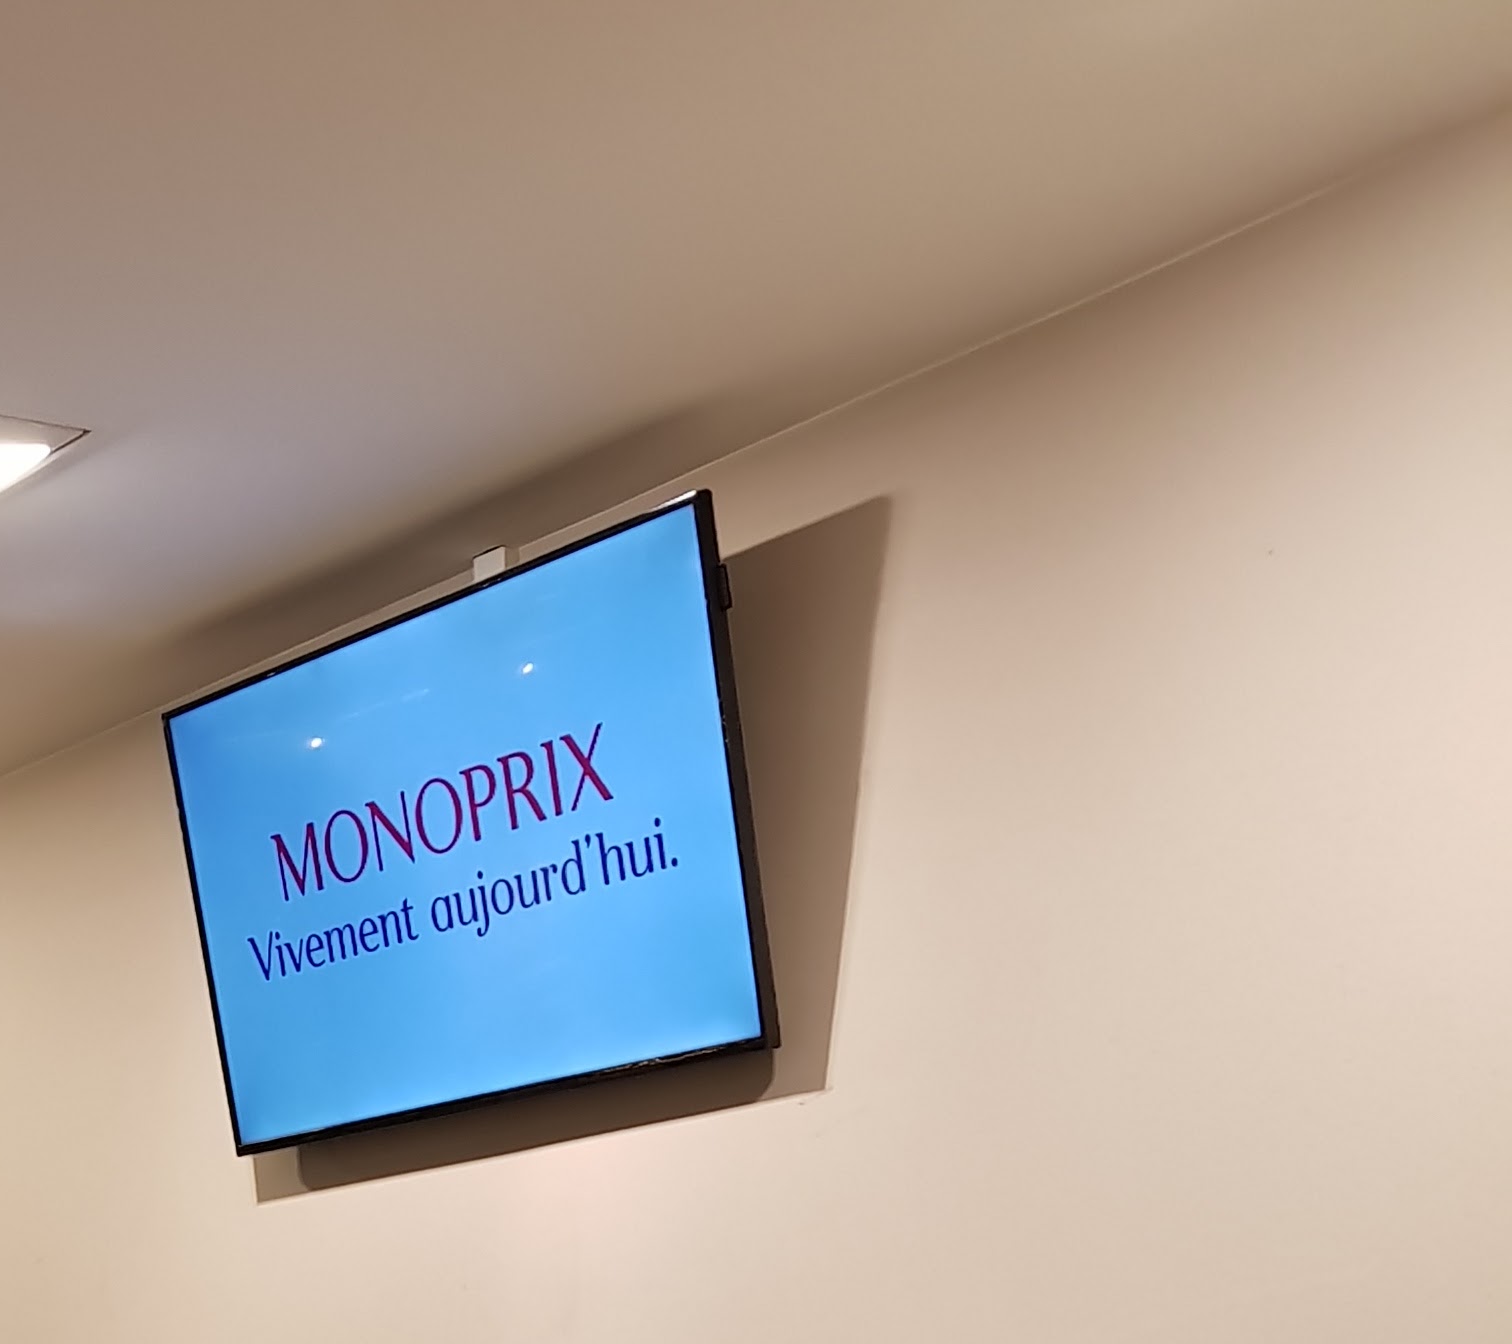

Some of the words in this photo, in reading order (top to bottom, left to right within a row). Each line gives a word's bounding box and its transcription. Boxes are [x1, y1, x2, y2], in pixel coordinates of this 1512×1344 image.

[270, 722, 615, 902] MONOPRIX
[247, 897, 419, 983] Vivement
[430, 817, 680, 937] aujourd'hui.
